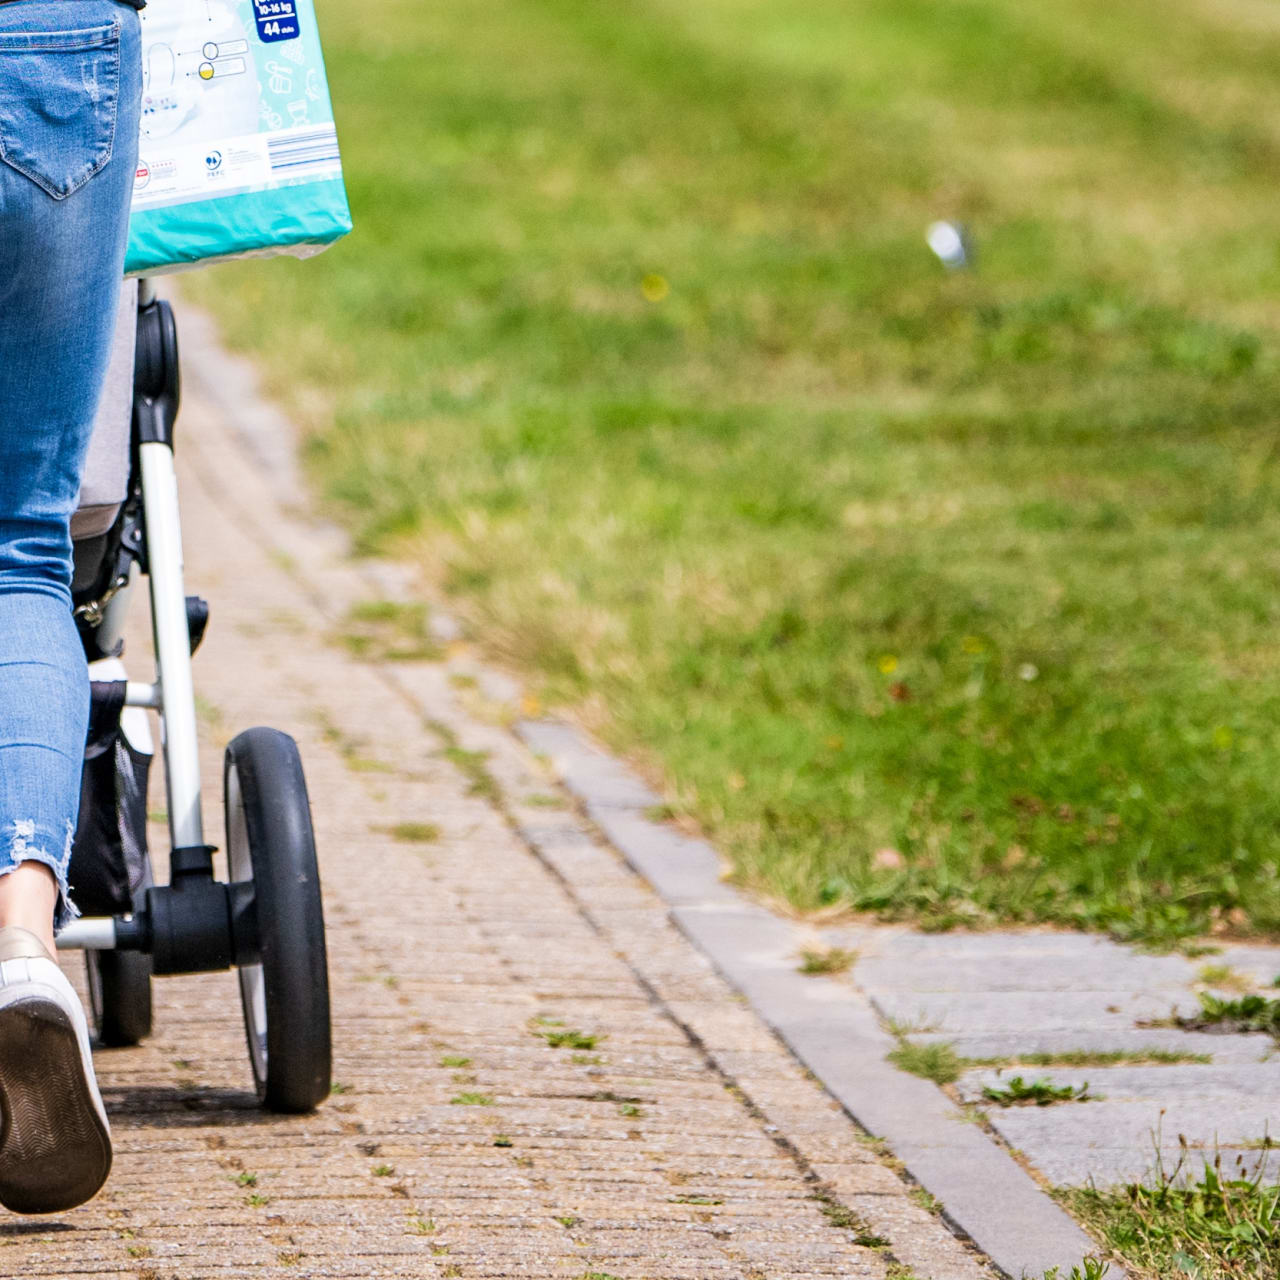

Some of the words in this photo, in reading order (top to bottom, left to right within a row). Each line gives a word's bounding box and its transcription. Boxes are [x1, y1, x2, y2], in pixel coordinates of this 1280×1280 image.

[258, 3, 281, 15] 10-16
[280, 1, 292, 14] kg
[263, 21, 280, 36] 44
